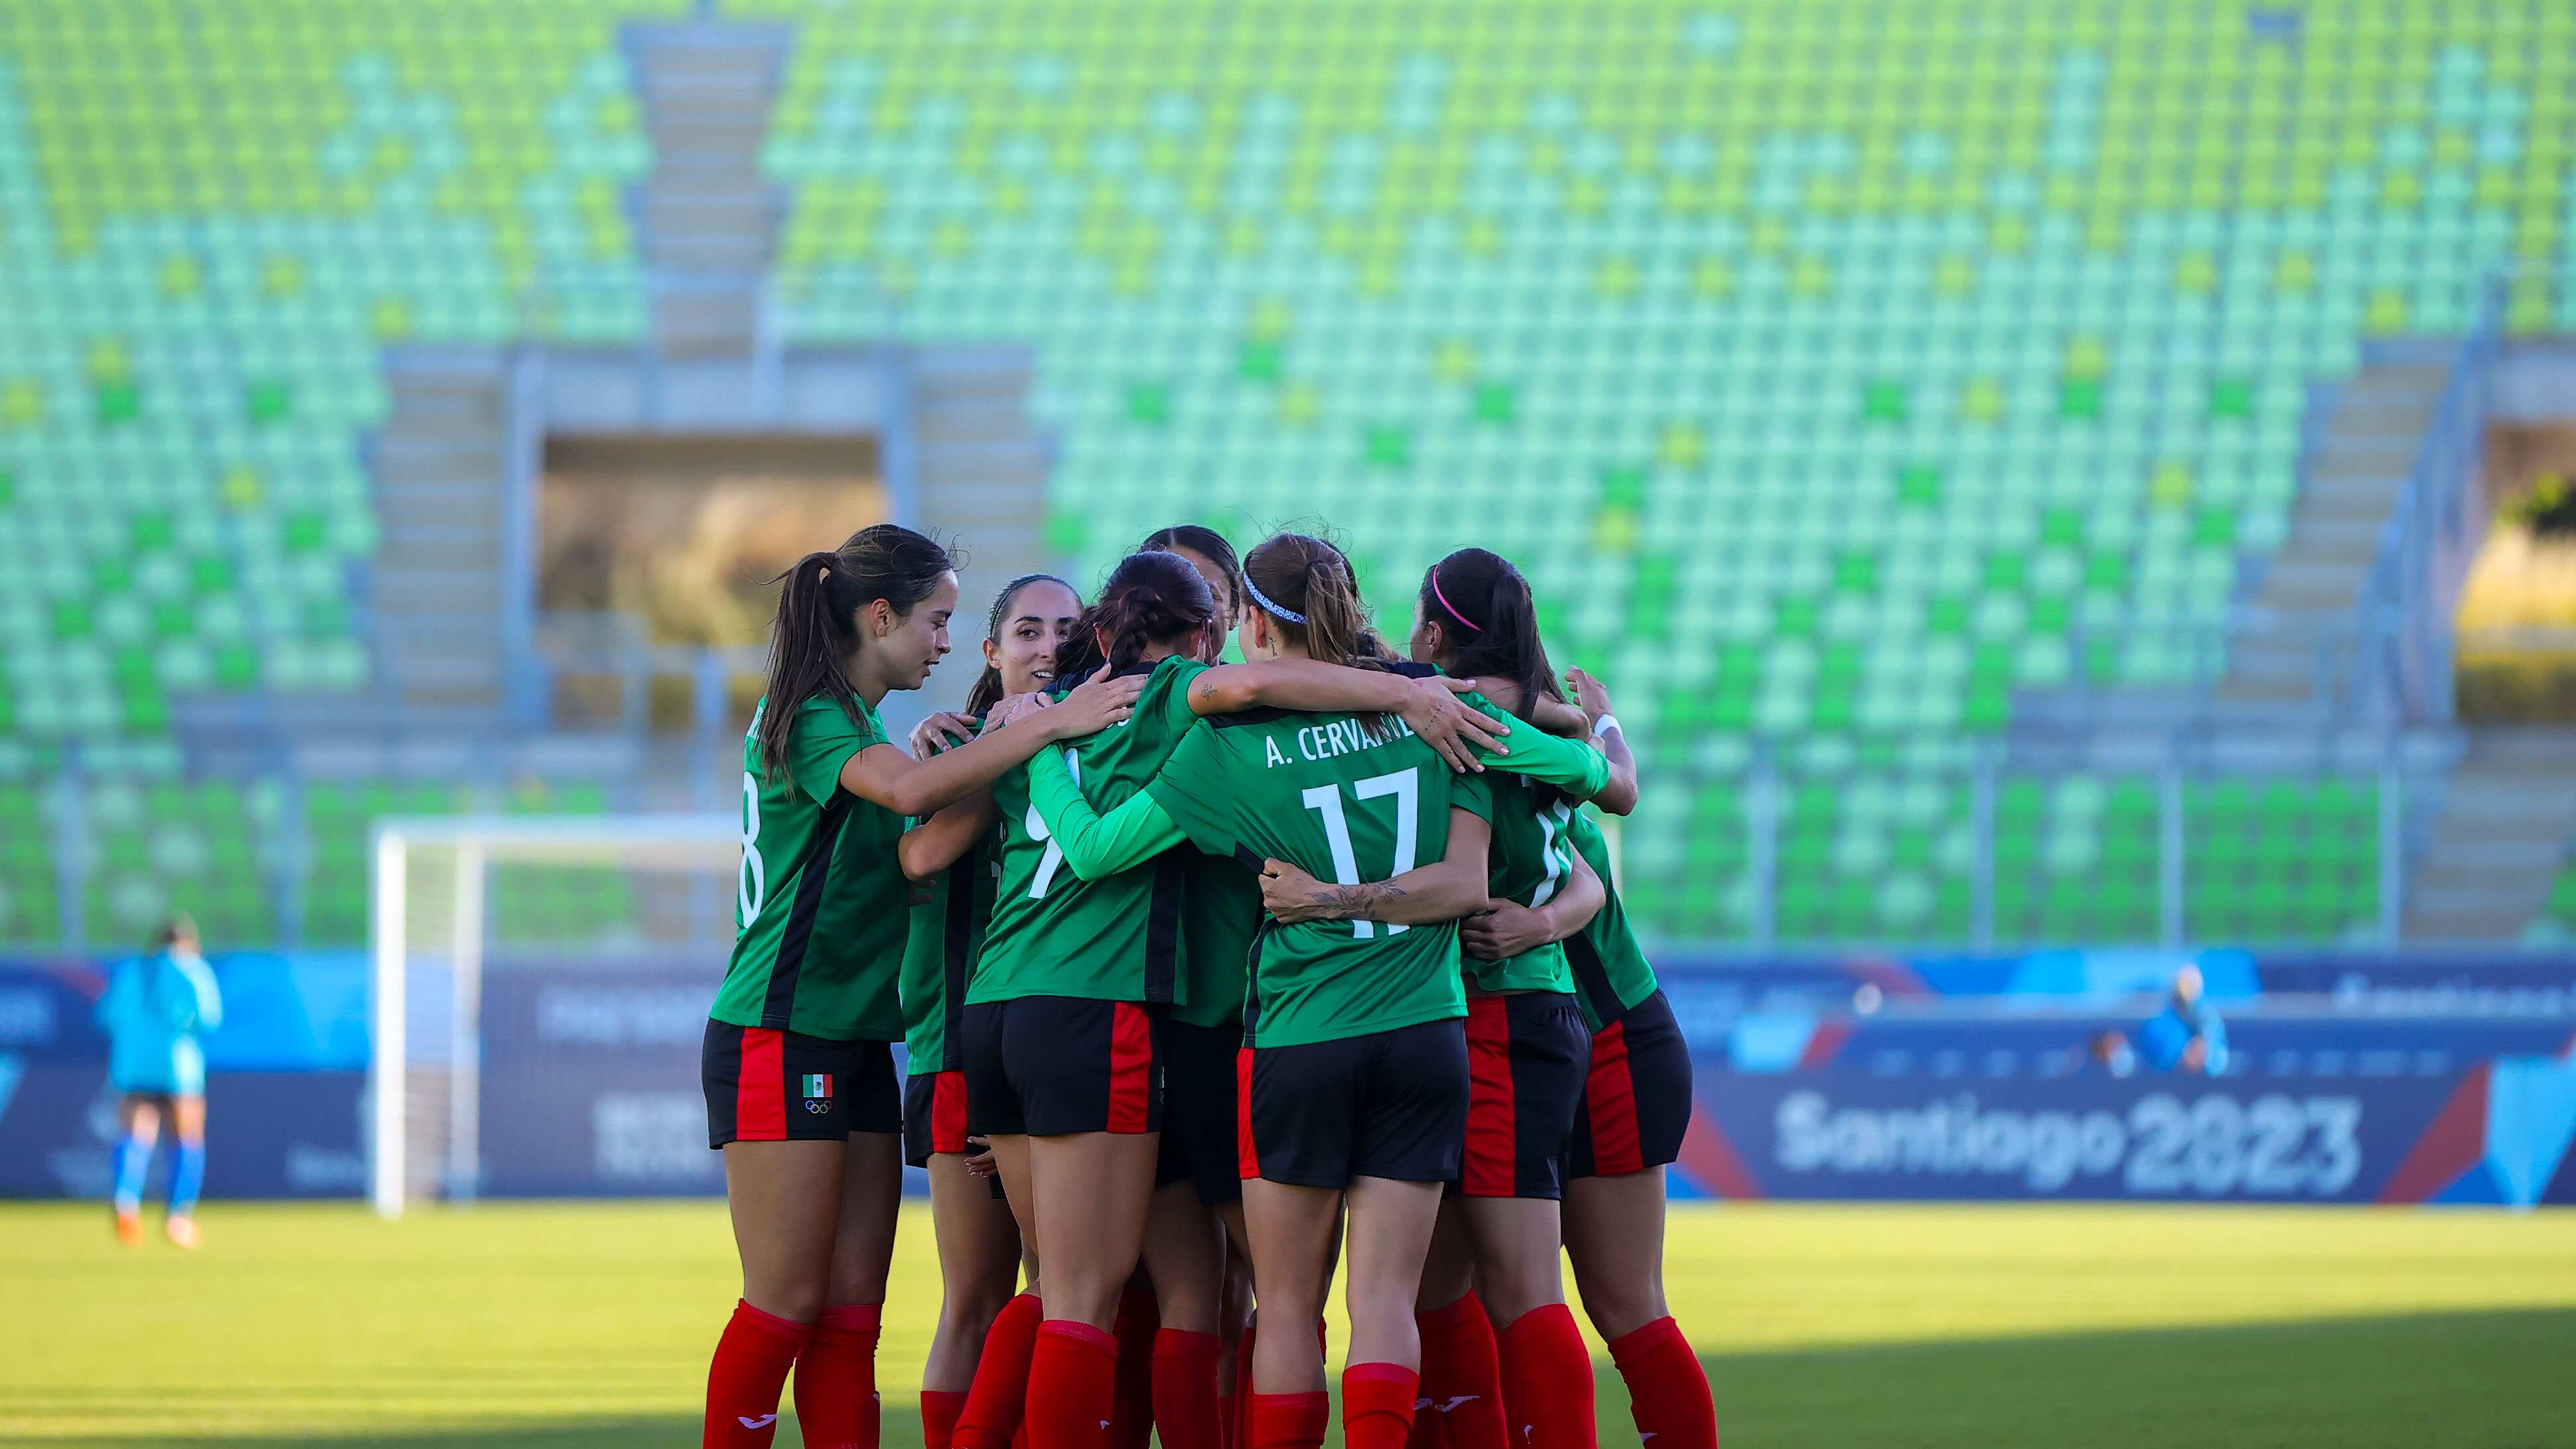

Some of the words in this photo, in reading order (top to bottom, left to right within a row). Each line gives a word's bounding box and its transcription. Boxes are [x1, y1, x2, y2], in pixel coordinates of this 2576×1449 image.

[1266, 735, 1293, 768] A.
[1302, 766, 1418, 939] 17
[1775, 1091, 2123, 1192] Santiago
